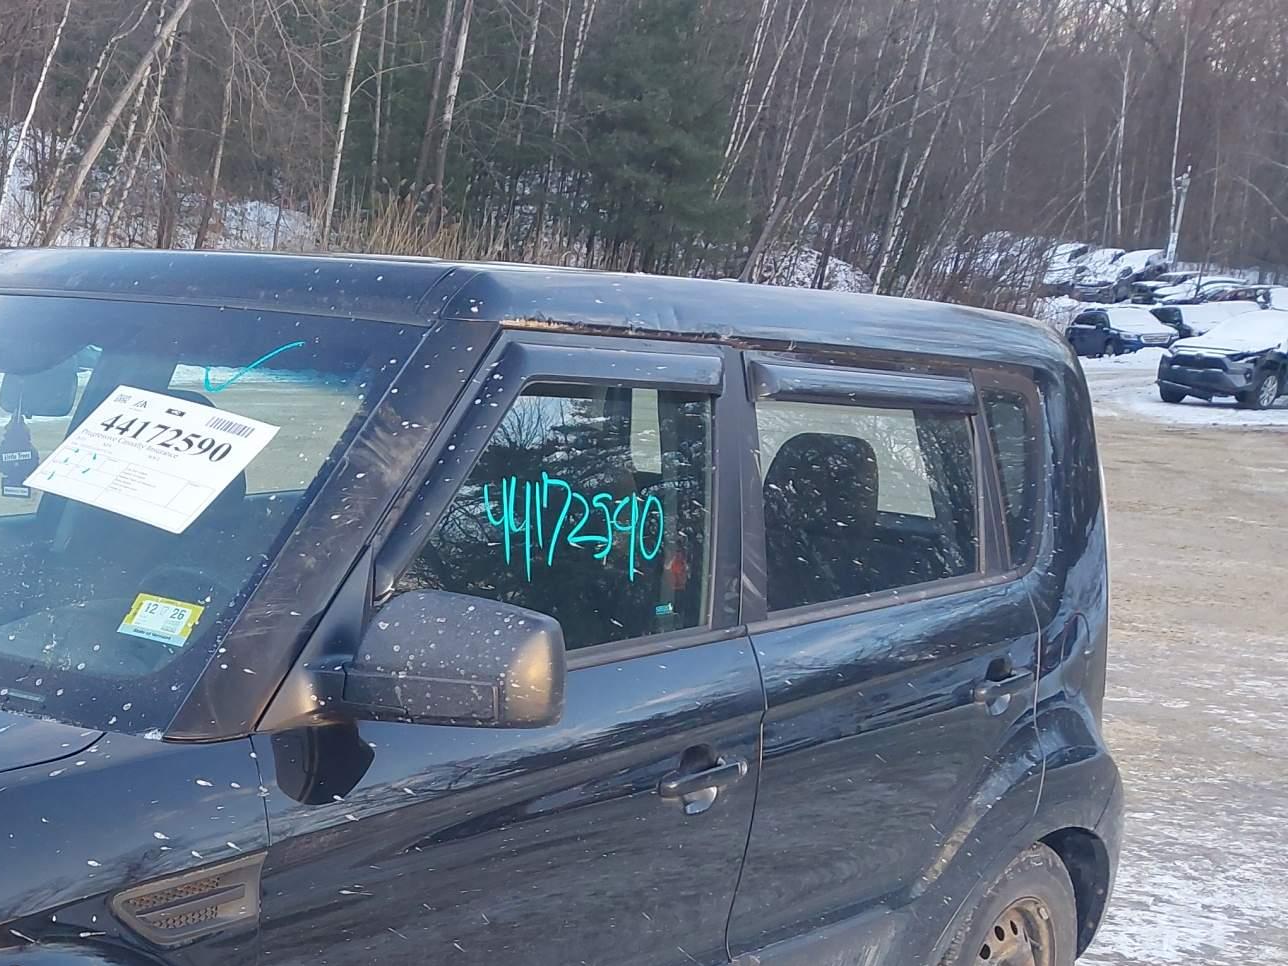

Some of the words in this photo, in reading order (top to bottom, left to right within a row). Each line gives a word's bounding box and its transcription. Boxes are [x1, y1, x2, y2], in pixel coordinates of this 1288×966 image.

[100, 413, 232, 462] 44172590
[145, 444, 179, 460] Insurance
[484, 472, 663, 583] 44172590
[144, 602, 159, 614] 12
[169, 608, 186, 620] 26
